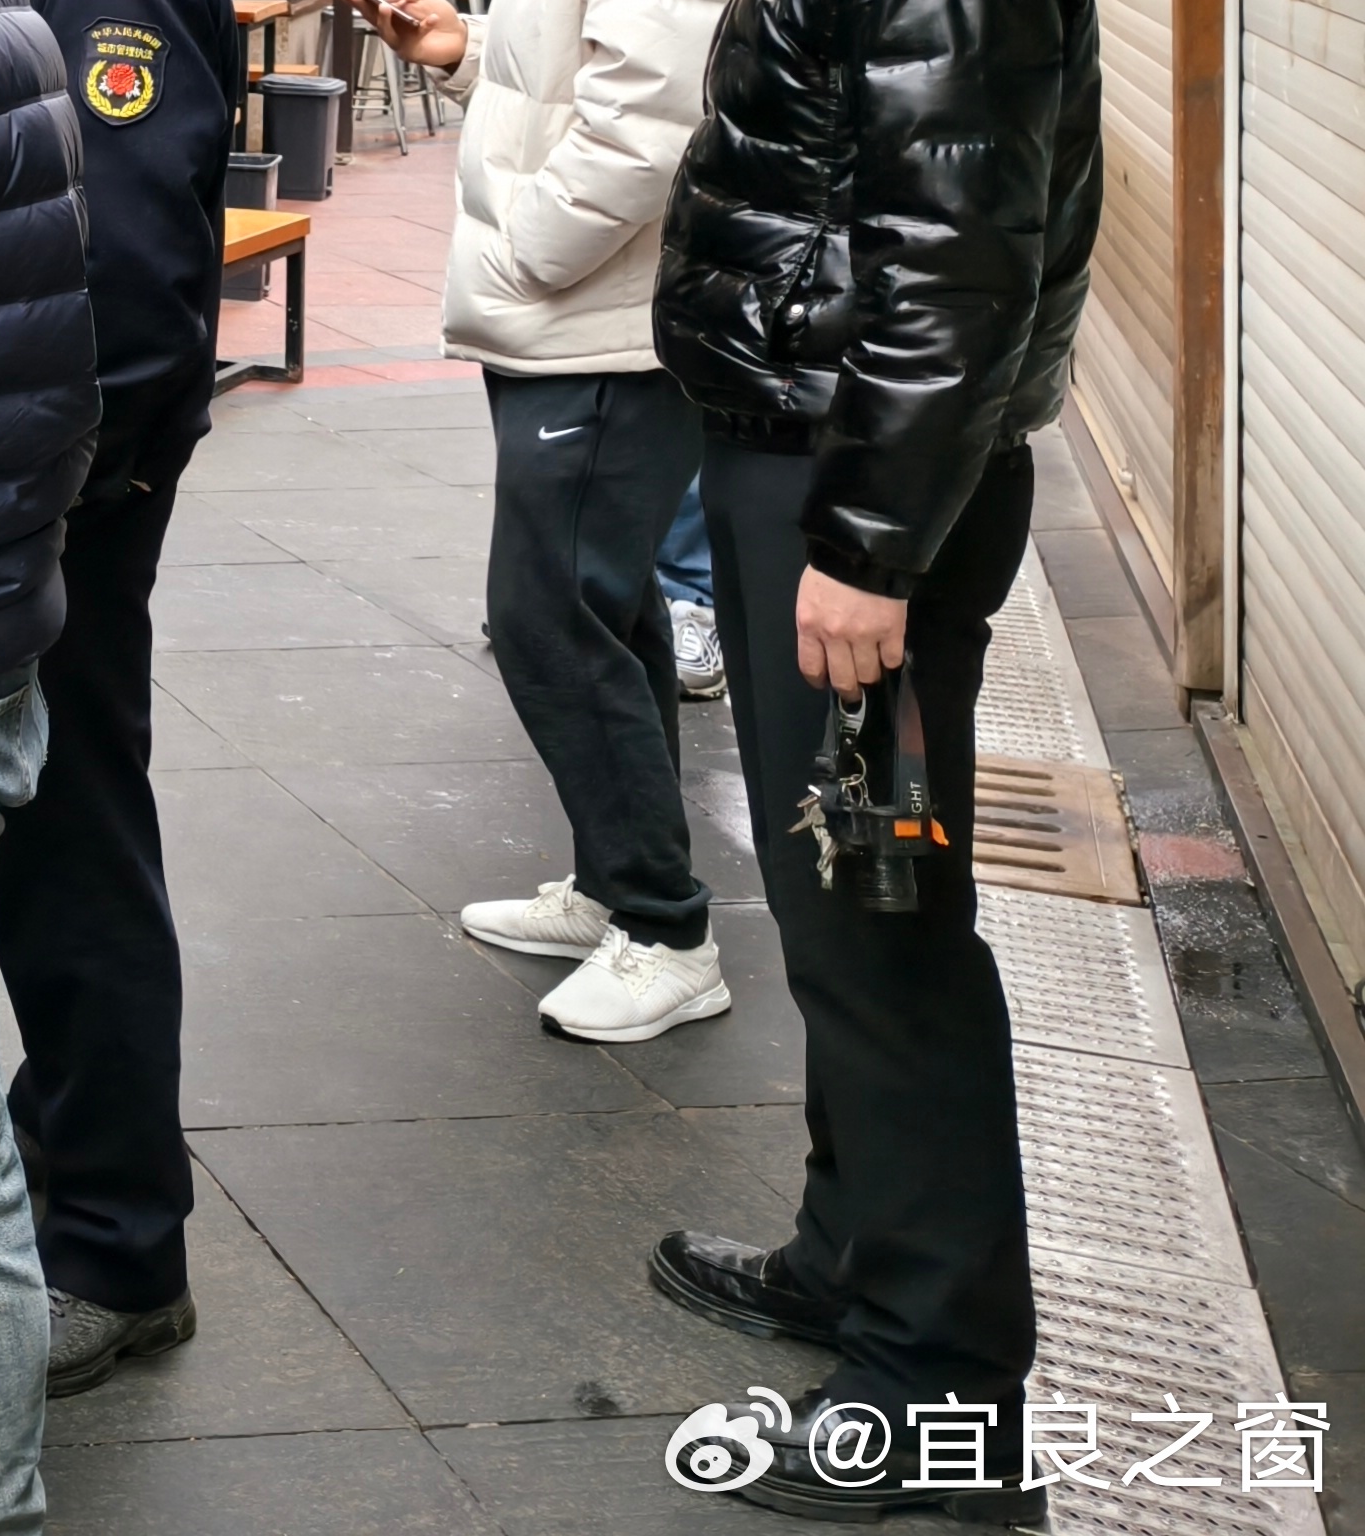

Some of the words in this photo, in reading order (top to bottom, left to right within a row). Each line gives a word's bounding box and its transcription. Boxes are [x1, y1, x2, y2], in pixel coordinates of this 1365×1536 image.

[91, 26, 162, 50] 中华人民共和国
[96, 42, 155, 61] 城市管理执法
